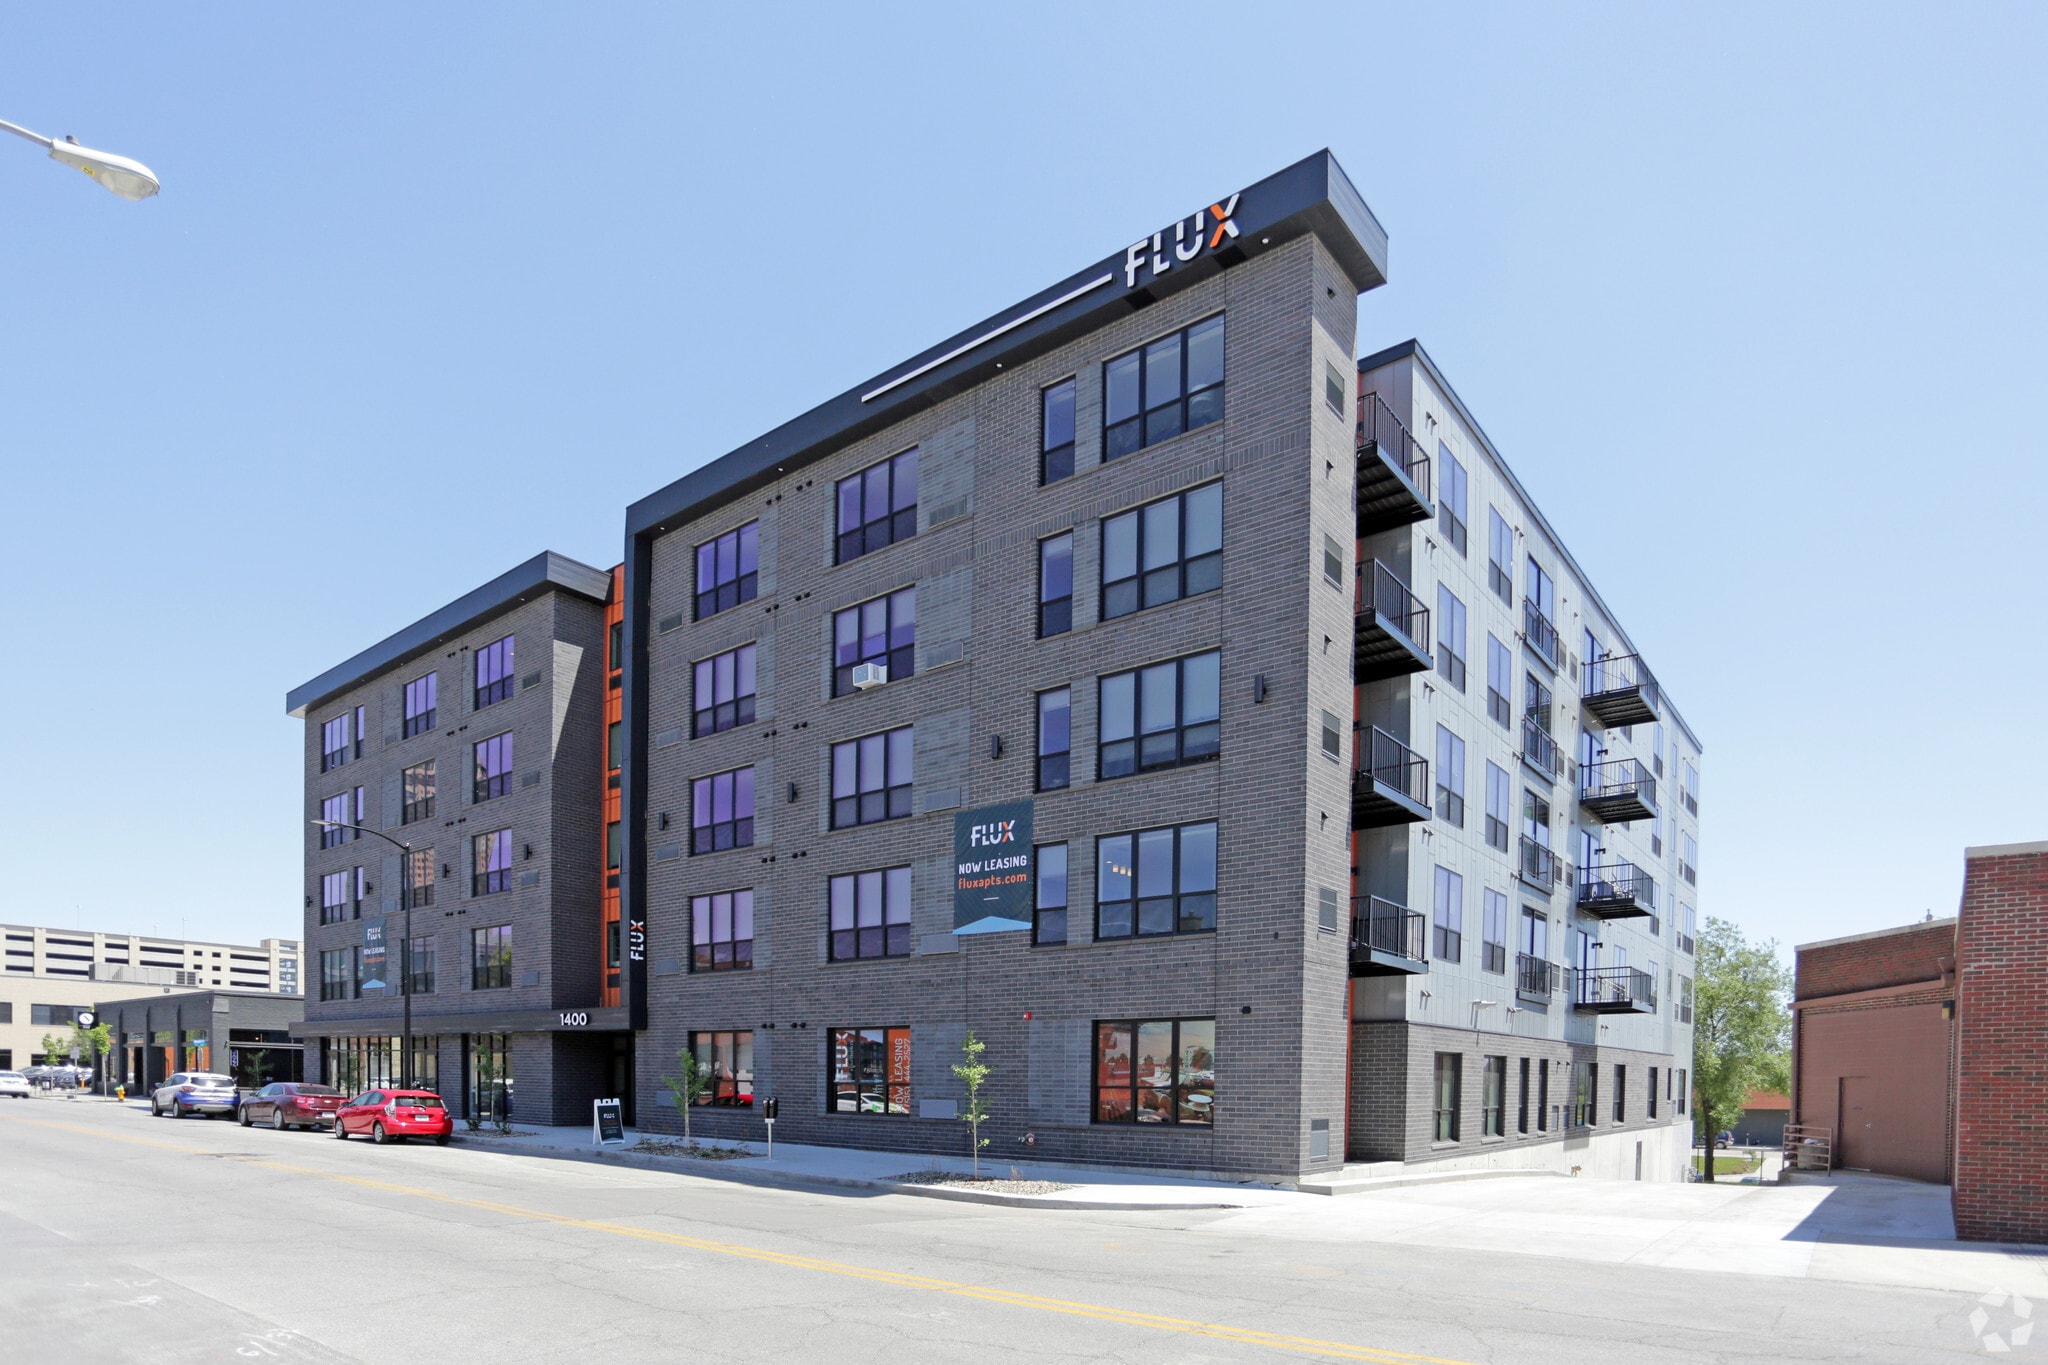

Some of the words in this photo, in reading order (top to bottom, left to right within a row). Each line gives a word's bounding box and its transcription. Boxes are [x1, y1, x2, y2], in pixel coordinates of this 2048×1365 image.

[1125, 193, 1240, 288] FLUX
[971, 820, 1015, 847] FLUX
[958, 861, 981, 875] NOW
[984, 855, 1027, 872] LEASING
[958, 874, 1027, 889] fluxapts.com
[367, 927, 381, 940] FLUX
[630, 920, 644, 960] FLUX
[559, 1012, 587, 1025] 1400
[835, 1032, 849, 1081] FLUX
[895, 1038, 903, 1081] LEASING
